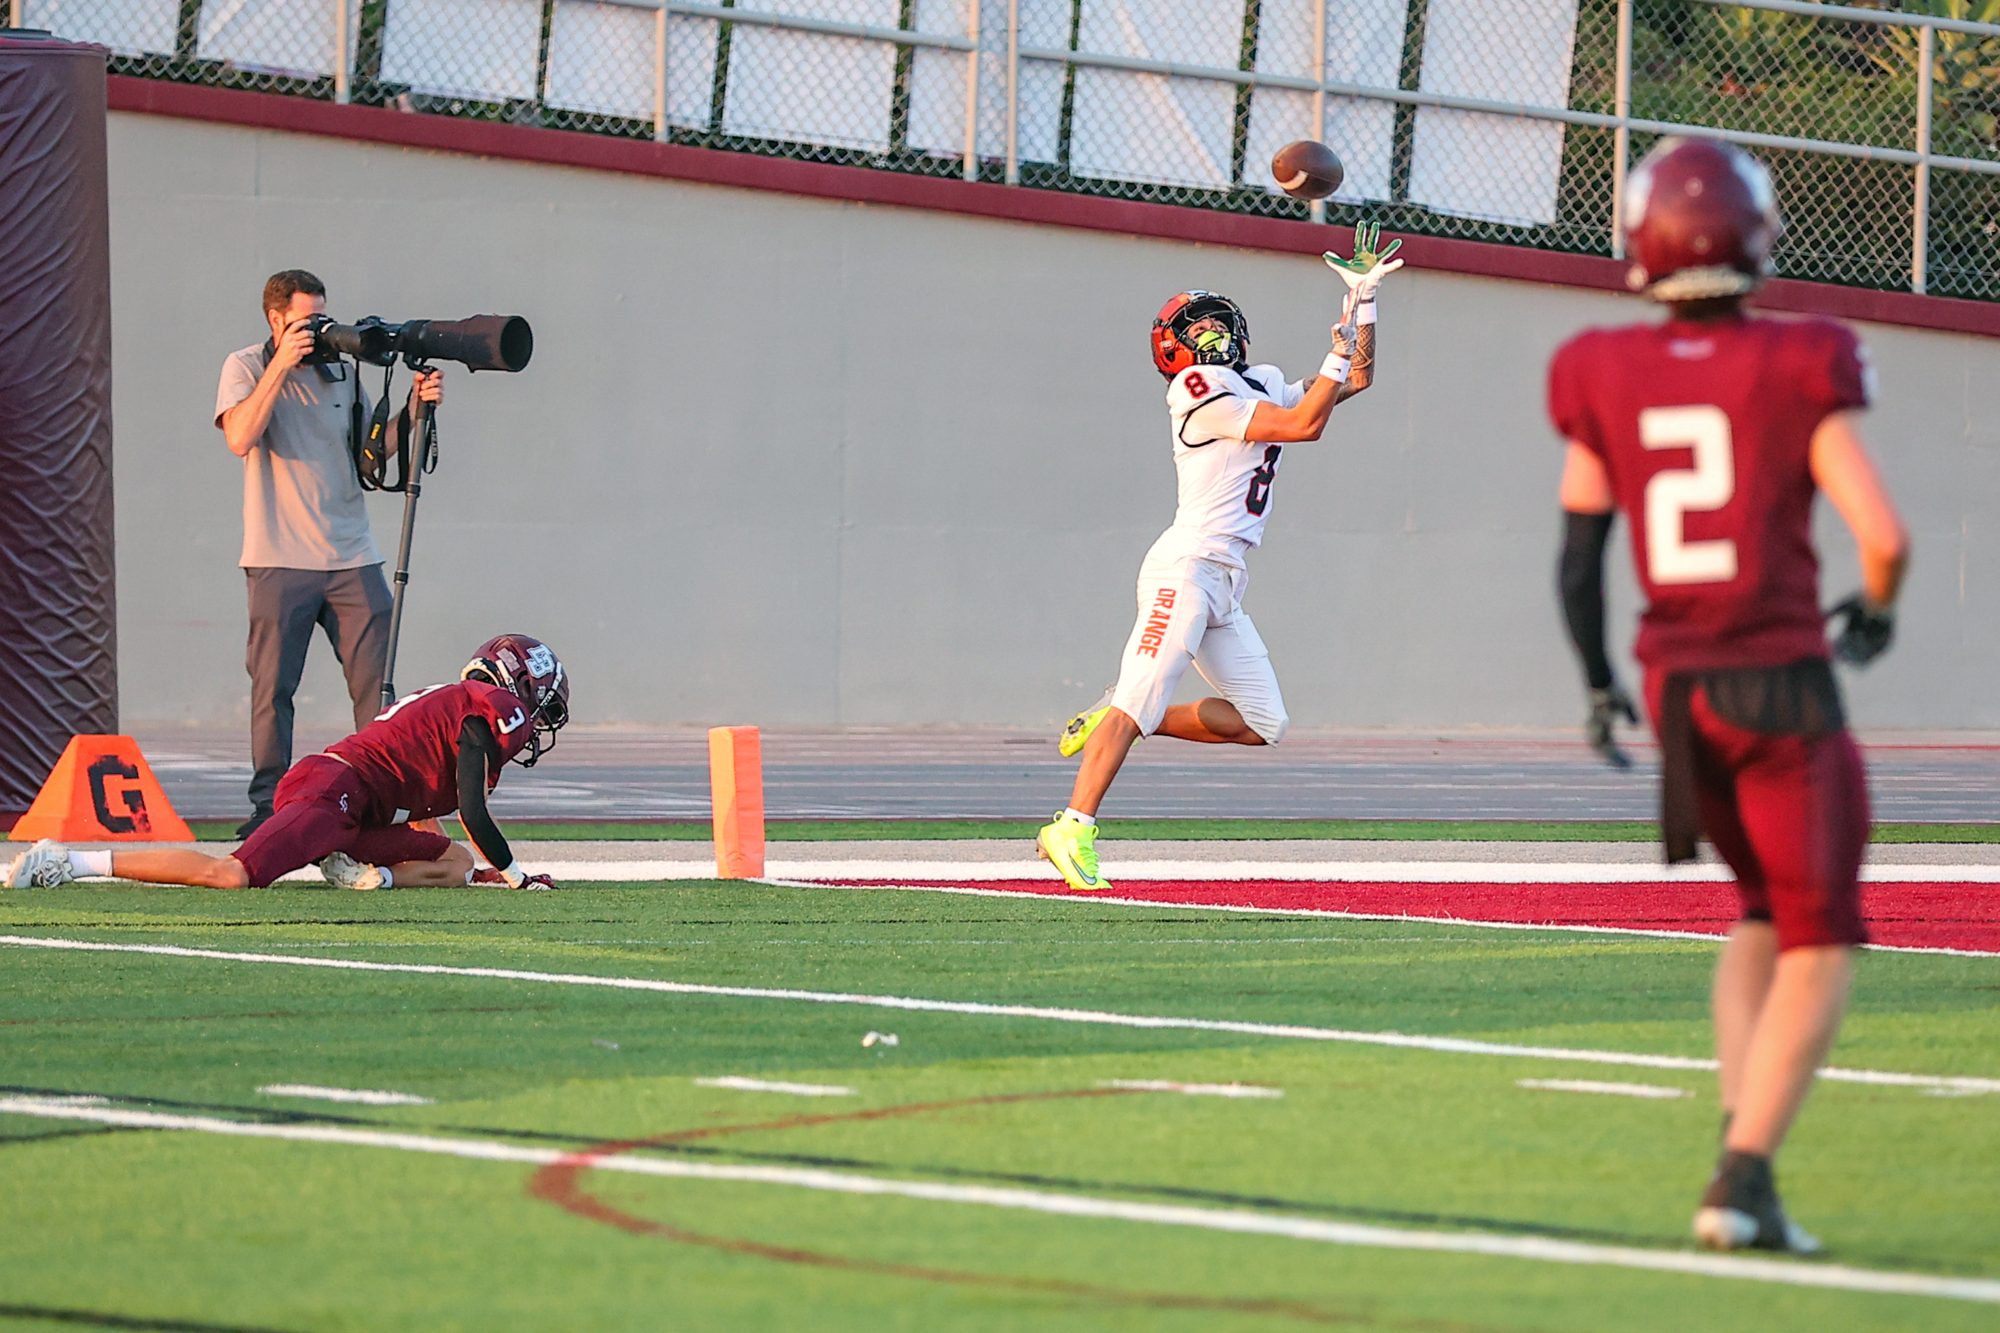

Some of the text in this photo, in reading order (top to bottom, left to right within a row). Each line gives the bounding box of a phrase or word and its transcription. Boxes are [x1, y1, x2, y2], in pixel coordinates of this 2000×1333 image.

[1184, 371, 1210, 399] 8
[1245, 444, 1282, 517] 8
[1638, 404, 1739, 585] 2
[1136, 588, 1177, 659] ORANGE
[497, 706, 526, 735] 3
[87, 754, 151, 833] G
